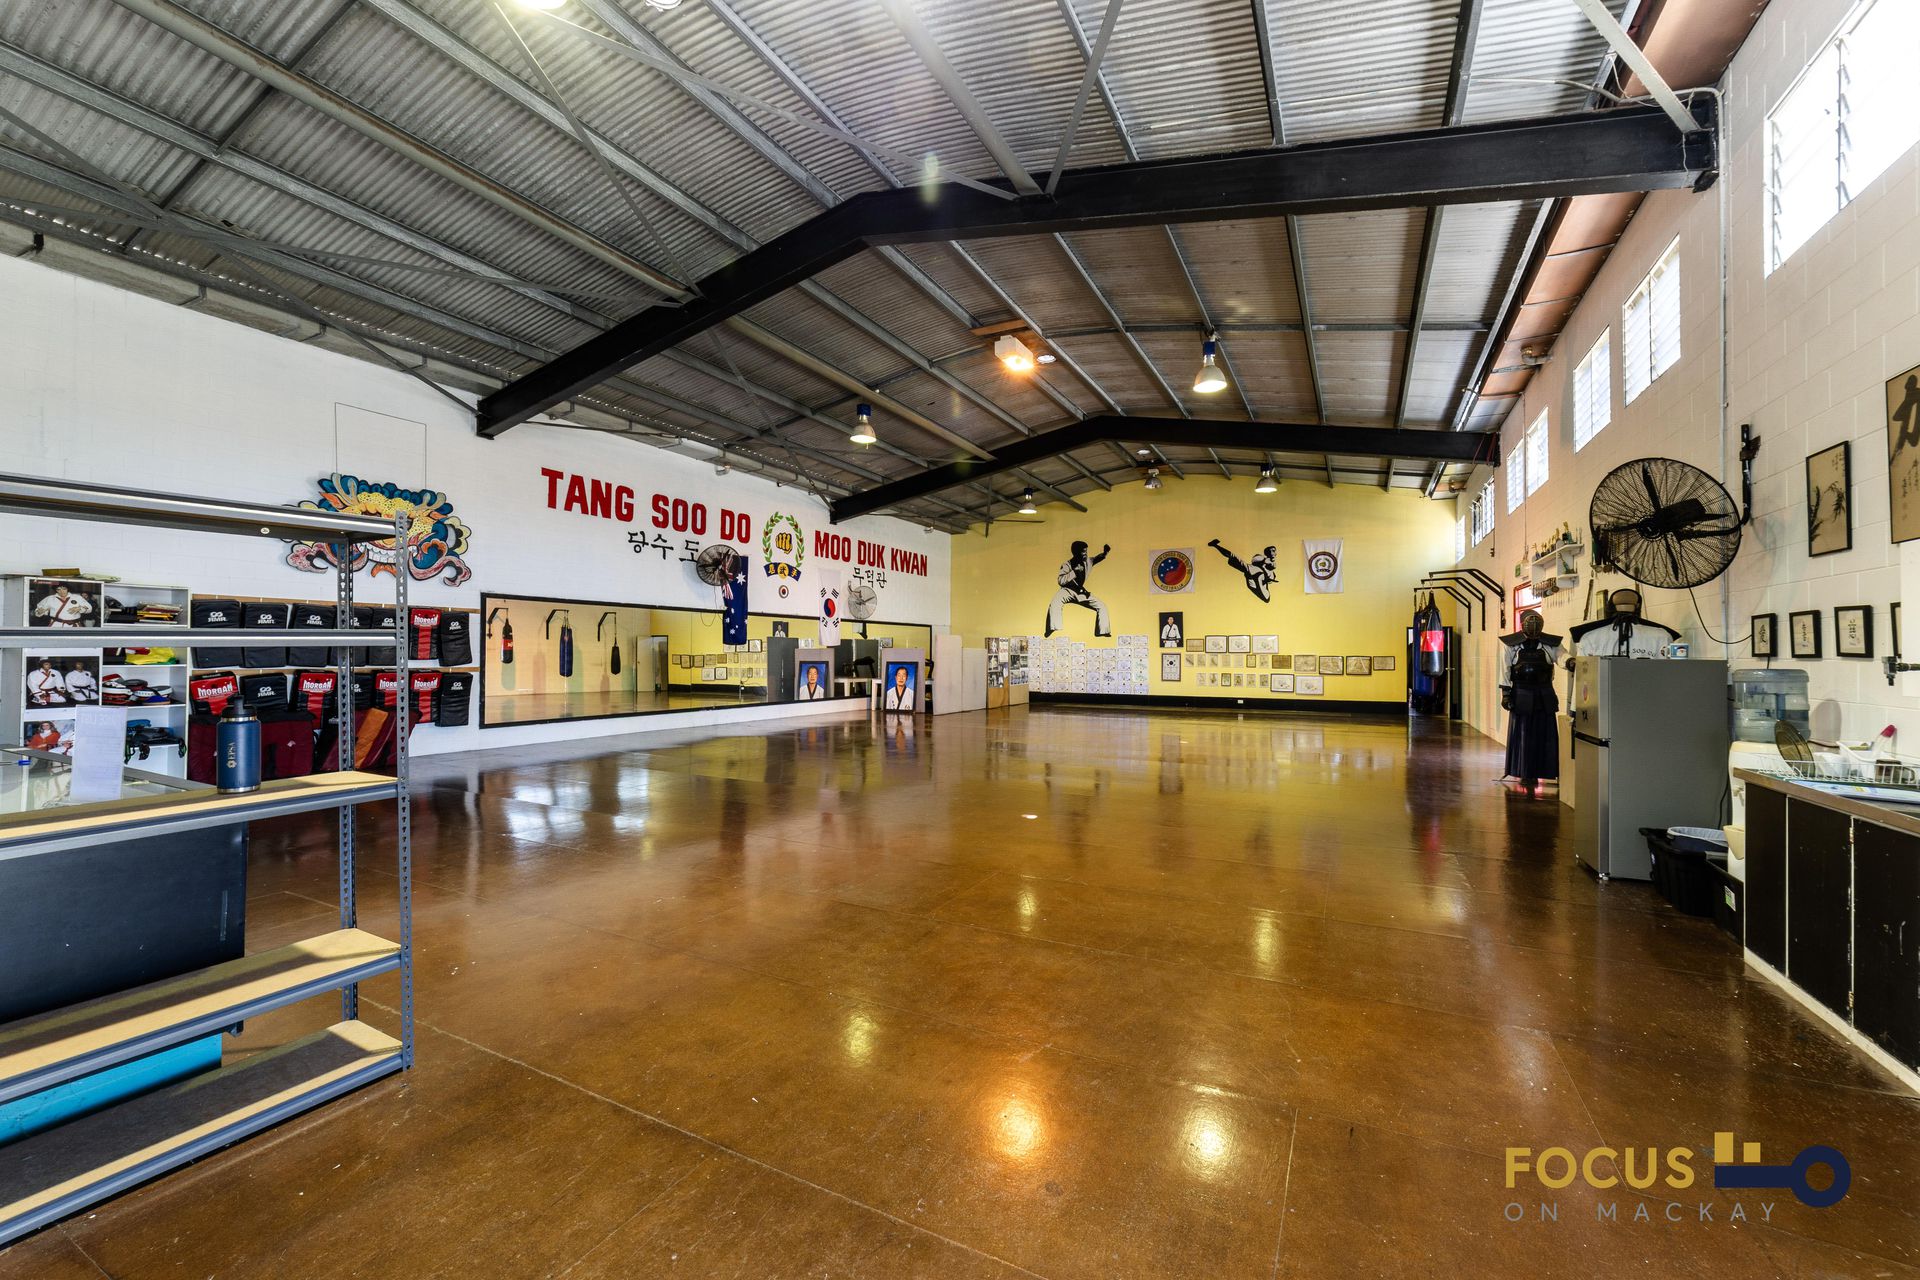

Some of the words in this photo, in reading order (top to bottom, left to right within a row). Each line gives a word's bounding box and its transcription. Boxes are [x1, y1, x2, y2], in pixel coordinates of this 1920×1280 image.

[541, 467, 635, 523] TANG
[651, 493, 707, 536] SOO
[720, 508, 751, 544] DO
[814, 529, 852, 563] MOO
[857, 539, 886, 570] DUK
[890, 547, 928, 577] KWAN
[197, 681, 233, 698] MORGAN
[303, 678, 332, 691] MORGAN
